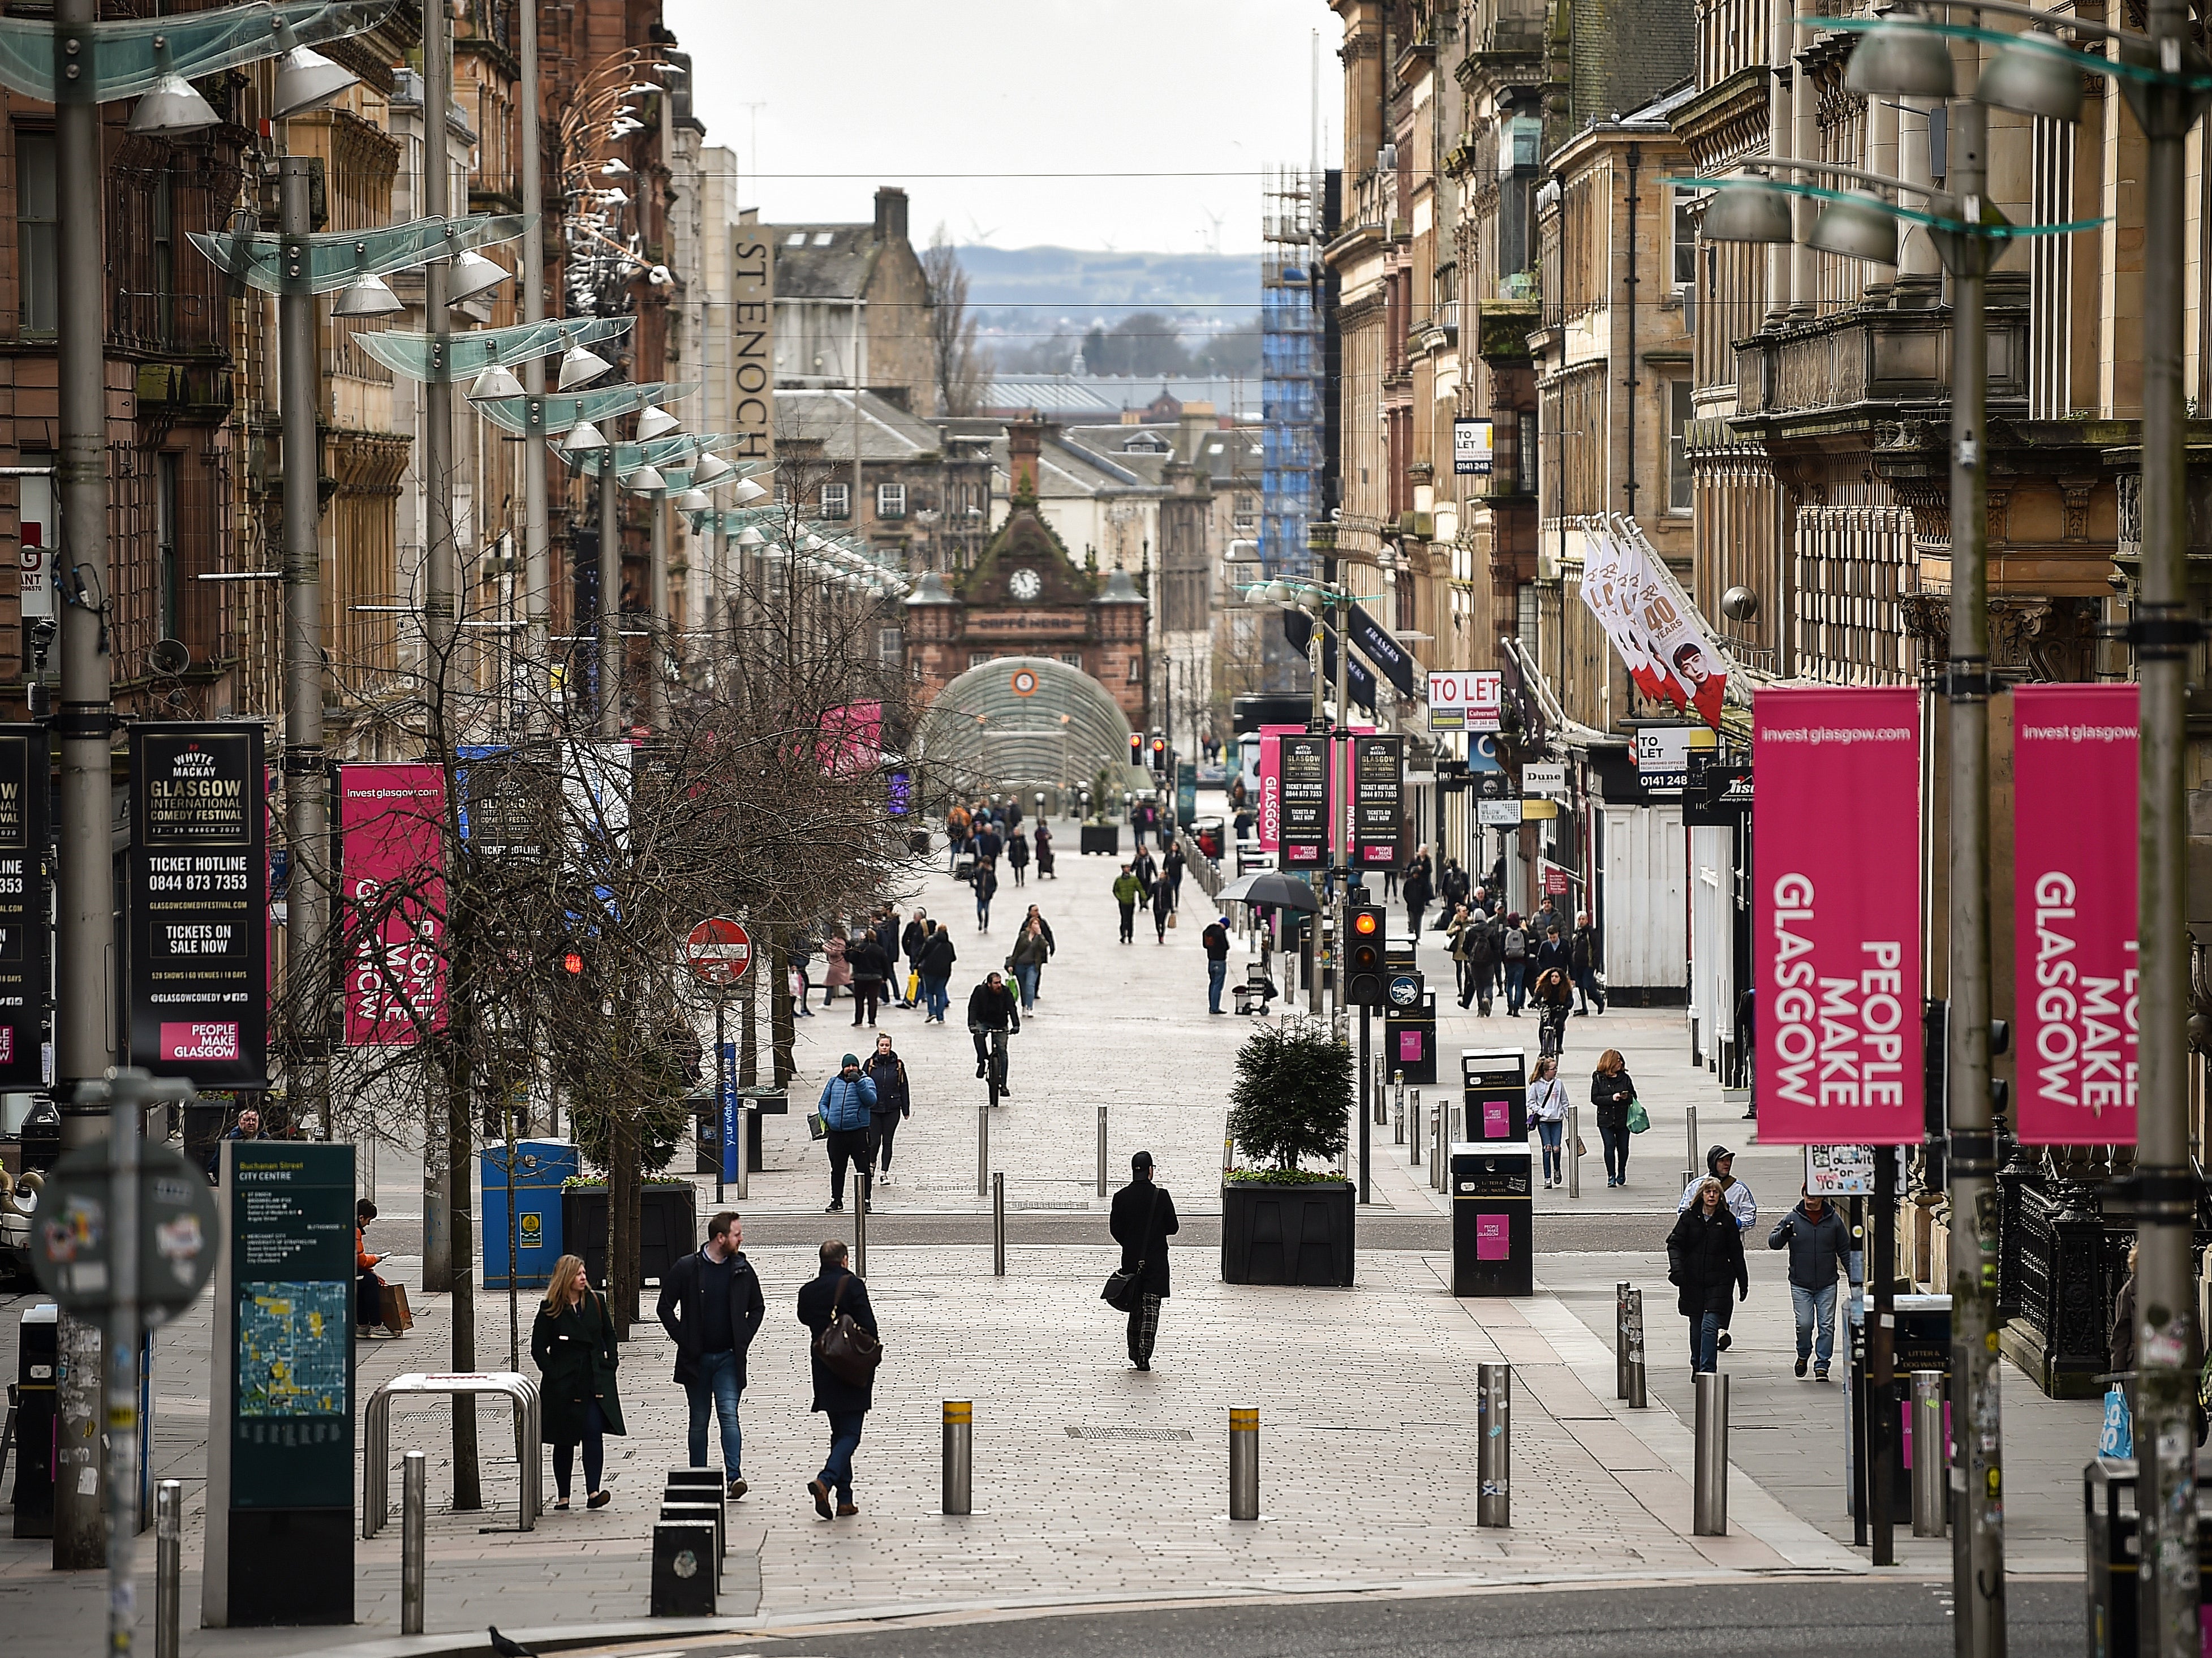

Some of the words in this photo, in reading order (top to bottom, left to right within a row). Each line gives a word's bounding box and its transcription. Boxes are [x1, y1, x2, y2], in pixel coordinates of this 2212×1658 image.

[736, 242, 766, 286] ST
[737, 300, 766, 458] ENOCH
[1643, 596, 1676, 631] 40
[1655, 618, 1683, 641] YEARS
[1365, 626, 1400, 663] FRASERS
[1348, 658, 1366, 681] SERS
[1430, 678, 1457, 701] TO
[1465, 678, 1500, 701] LET
[1640, 737, 1658, 746] TO
[174, 753, 214, 766] WHYTE
[1640, 748, 1664, 758] LET
[173, 767, 216, 777] MACKAY
[1641, 776, 1664, 786] 0141
[1667, 775, 1688, 785] 248
[150, 780, 242, 797] GLASGOW
[150, 798, 242, 809] INTERNATIONAL
[1266, 776, 1277, 841] GLASGOW
[150, 810, 193, 821] COMEDY
[196, 810, 243, 821] FESTIVAL
[149, 857, 192, 871] TICKET
[195, 857, 247, 871] HOTLINE
[149, 875, 182, 891] 0844
[186, 874, 210, 891] 873
[215, 874, 247, 890] 7353
[166, 925, 212, 939] TICKETS
[216, 925, 231, 939] ON
[170, 940, 198, 953] SALE
[201, 940, 227, 953] NOW
[1773, 872, 1815, 1107] GLASGOW
[2035, 871, 2078, 1107] GLASGOW
[150, 993, 221, 1003] @GLASGOWCOMEDY
[192, 1024, 235, 1036] PEOPLE
[1861, 941, 1903, 1107] PEOPLE
[201, 1036, 235, 1047] MAKE
[1818, 977, 1859, 1107] MAKE
[2080, 977, 2122, 1107] MAKE
[174, 1046, 235, 1058] GLASGOW
[239, 1172, 257, 1181] CITY
[259, 1171, 292, 1181] CENTRE
